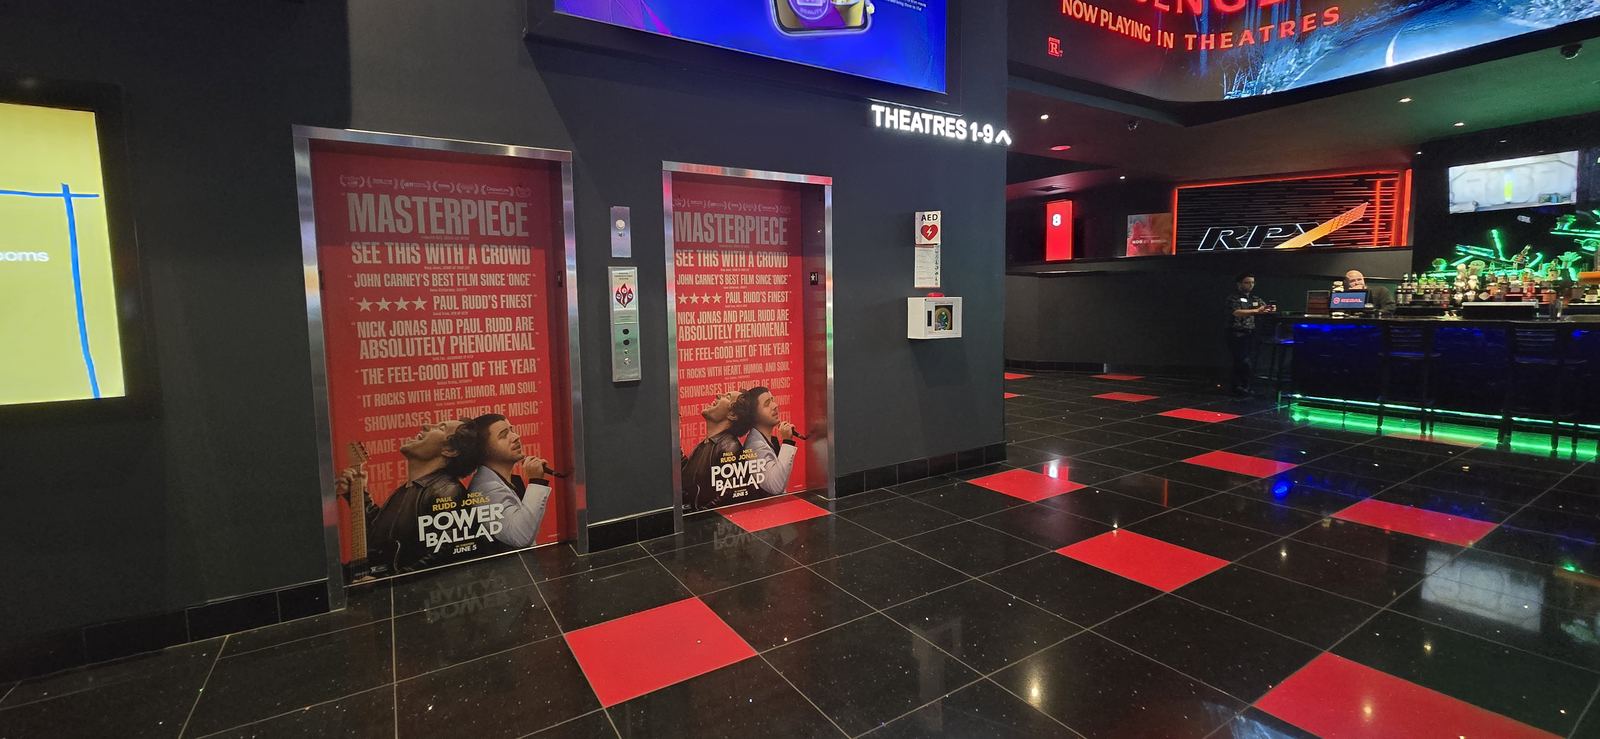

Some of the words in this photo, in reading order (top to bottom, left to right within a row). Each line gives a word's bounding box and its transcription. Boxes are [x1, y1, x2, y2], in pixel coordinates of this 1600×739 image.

[1062, 0, 1099, 24] NOW
[1100, 12, 1151, 42] PLAYING
[1157, 30, 1175, 49] IN
[1184, 6, 1340, 50] THEATRES
[871, 104, 968, 140] THEATRES
[970, 122, 994, 144] 1-9
[1052, 213, 1062, 226] 8
[1198, 202, 1368, 251] RPX
[384, 242, 421, 265] THIS
[424, 243, 463, 265] WITH
[468, 244, 478, 265] A
[676, 249, 694, 267] SEE
[696, 250, 719, 267] THIS
[721, 250, 746, 267] WITH
[749, 251, 754, 267] A
[384, 274, 430, 287] CARNEY'S
[432, 274, 454, 287] BEST
[456, 273, 478, 286] FILM
[480, 273, 506, 286] SINCE
[677, 274, 694, 286] JOHN
[695, 274, 724, 285] CARNEY'S
[725, 274, 739, 285] BEST
[741, 274, 754, 284] FILM
[755, 274, 772, 284] SINCE
[433, 295, 460, 310] PAUL
[462, 295, 498, 310] RUDD'S
[726, 292, 742, 304] PAUL
[743, 291, 767, 303] RUDD'S
[677, 311, 696, 325] NICK
[697, 311, 721, 324] JONAS
[723, 310, 737, 323] AND
[739, 310, 756, 322] PAUL
[758, 309, 775, 322] RUDD
[776, 309, 789, 321] ARE
[389, 319, 428, 337] JONAS
[431, 318, 453, 335] AND
[456, 318, 483, 334] PAUL
[485, 317, 513, 333] RUDD
[515, 316, 534, 331] ARE
[679, 323, 732, 342] ABSOLUTELY
[360, 336, 446, 360] ABSOLUTELY
[679, 348, 694, 361] THE
[695, 346, 733, 361] FEEL-GOOD
[735, 346, 747, 358] HIT
[749, 345, 757, 358] OF
[758, 344, 771, 357] THE
[387, 363, 449, 384] FEEL-GOOD
[452, 362, 468, 379] HIT
[473, 361, 485, 377] OF
[488, 360, 508, 376] THE
[679, 368, 685, 379] IT
[686, 367, 706, 378] ROCKS
[707, 366, 722, 377] WITH
[765, 363, 775, 372] AND
[374, 392, 405, 407] ROCKS
[408, 390, 431, 405] WITH
[434, 387, 463, 403] HEART,
[465, 385, 498, 400] HUMOR,
[499, 383, 516, 396] AND
[679, 383, 722, 399] SHOWCASES
[724, 382, 736, 393] THE
[434, 409, 453, 423] THE
[456, 405, 491, 420] POWER
[494, 403, 506, 416] OF
[681, 422, 698, 437] THE
[365, 437, 398, 454] MADE
[739, 452, 758, 461] JONAS
[368, 461, 393, 481] THE
[711, 458, 767, 487] POWER
[716, 473, 765, 496] BALLAD
[432, 502, 456, 512] RUDD
[461, 496, 490, 507] JONAS
[418, 503, 504, 542] POWER
[426, 521, 503, 553] BALLAD
[453, 545, 472, 555] JUNE
